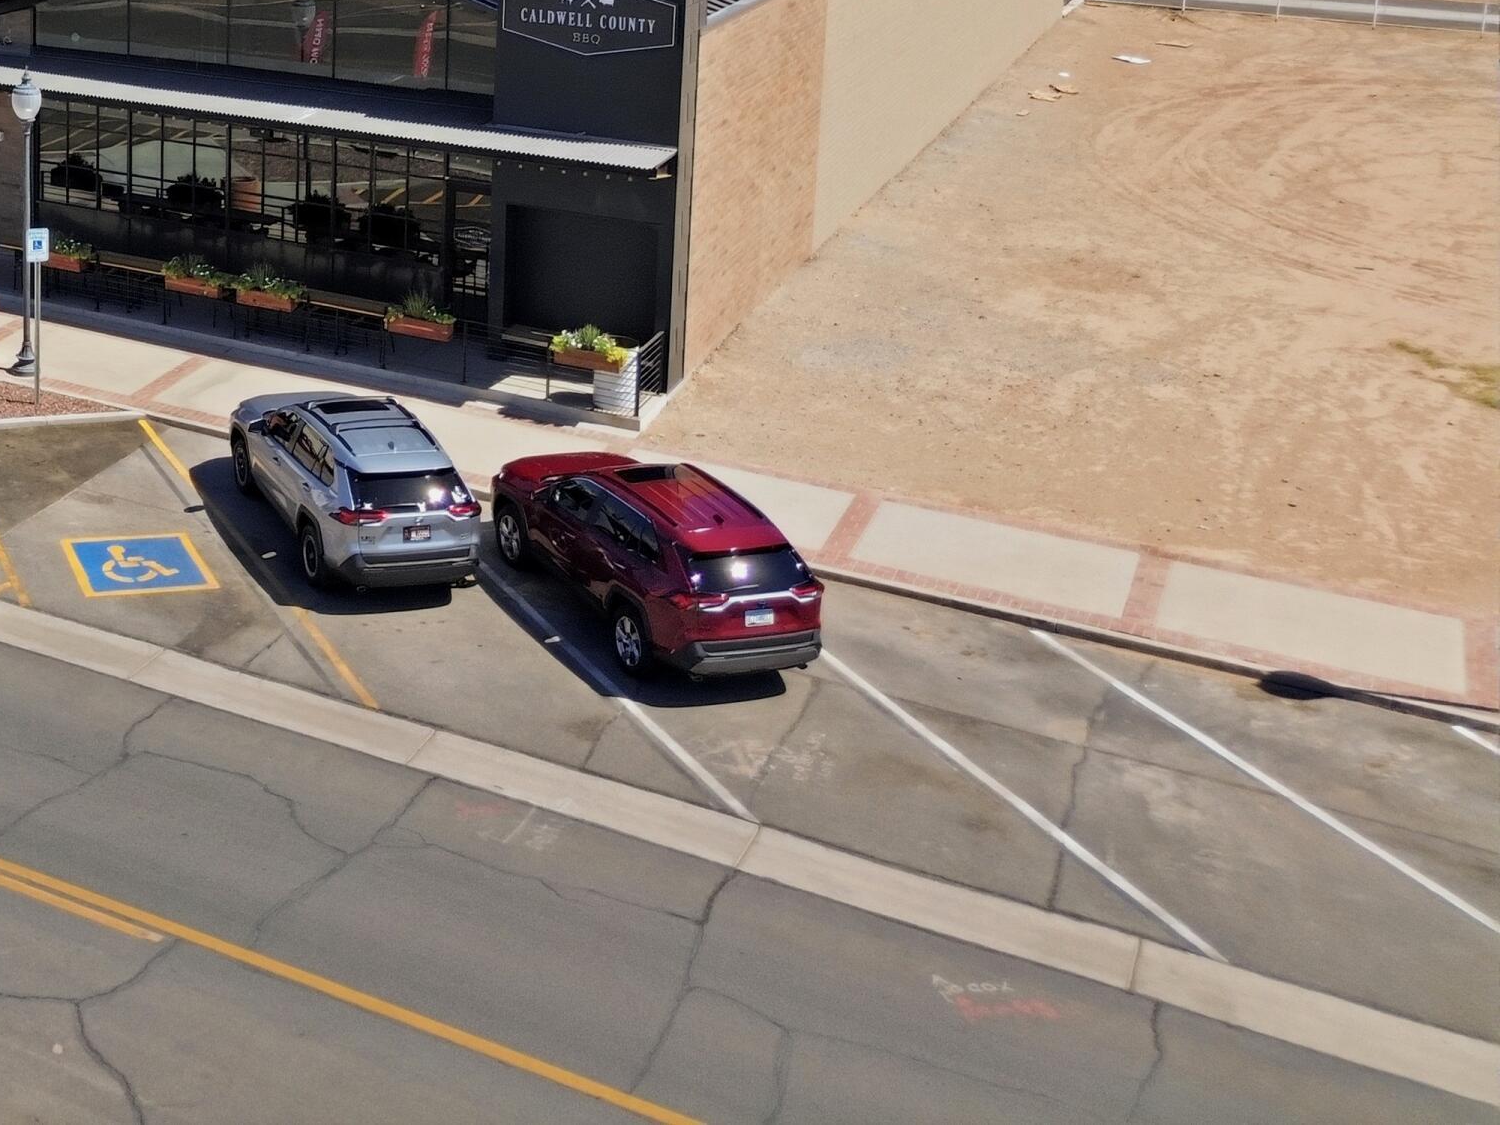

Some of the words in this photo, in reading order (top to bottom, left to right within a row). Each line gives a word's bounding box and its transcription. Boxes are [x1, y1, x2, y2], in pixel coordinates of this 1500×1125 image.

[520, 7, 593, 28] CALDWELL
[599, 14, 657, 35] COUNTY
[572, 32, 601, 45] BBQ
